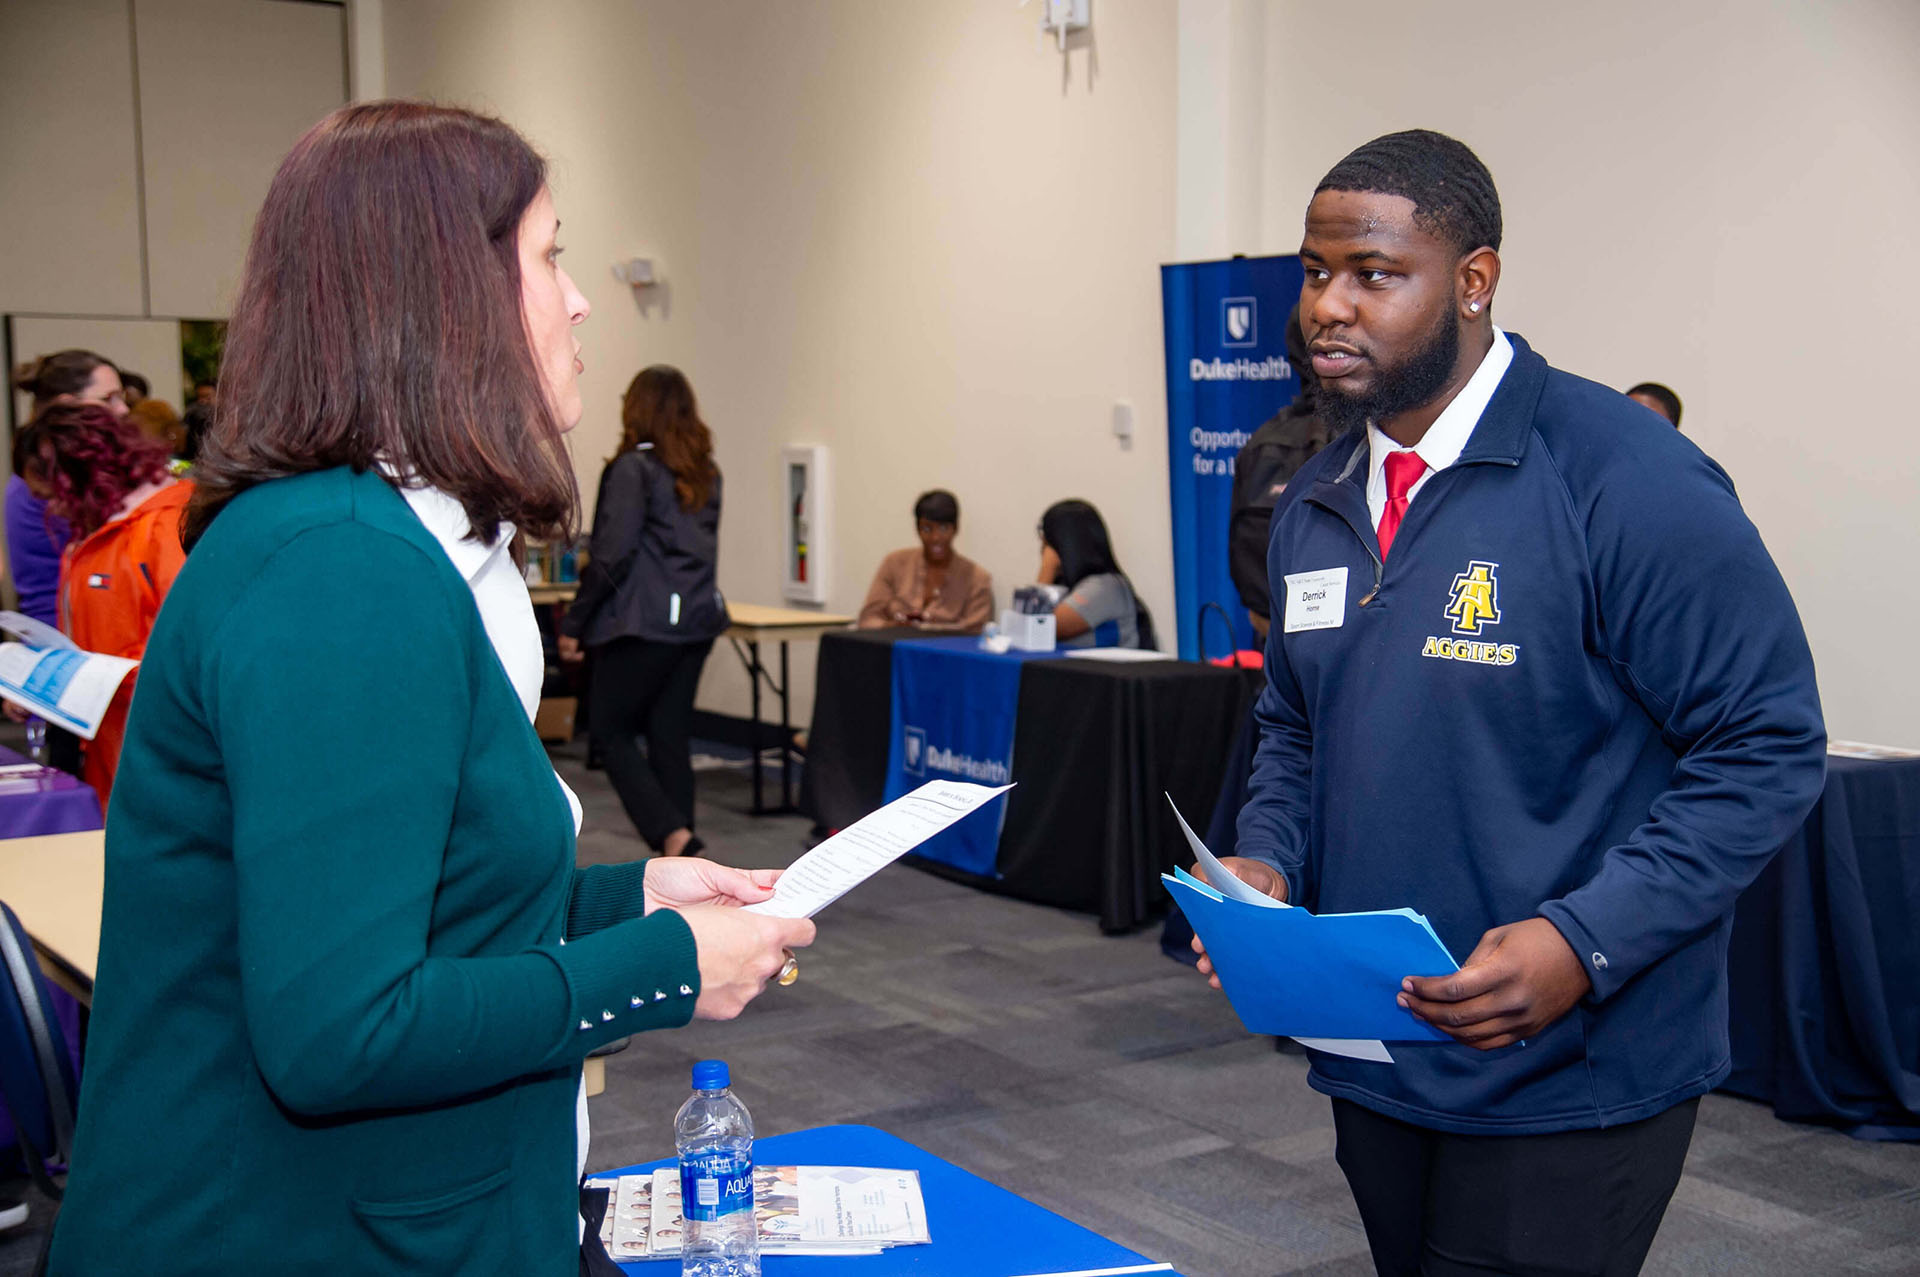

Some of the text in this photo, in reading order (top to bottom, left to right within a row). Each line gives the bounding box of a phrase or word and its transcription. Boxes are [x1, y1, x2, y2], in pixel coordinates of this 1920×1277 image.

[1190, 356, 1291, 380] DukeHealth
[1193, 453, 1214, 475] for
[1216, 459, 1226, 475] a
[1302, 589, 1327, 602] Derrick
[1422, 637, 1519, 666] AGGIES
[927, 745, 1009, 783] DukeHealth
